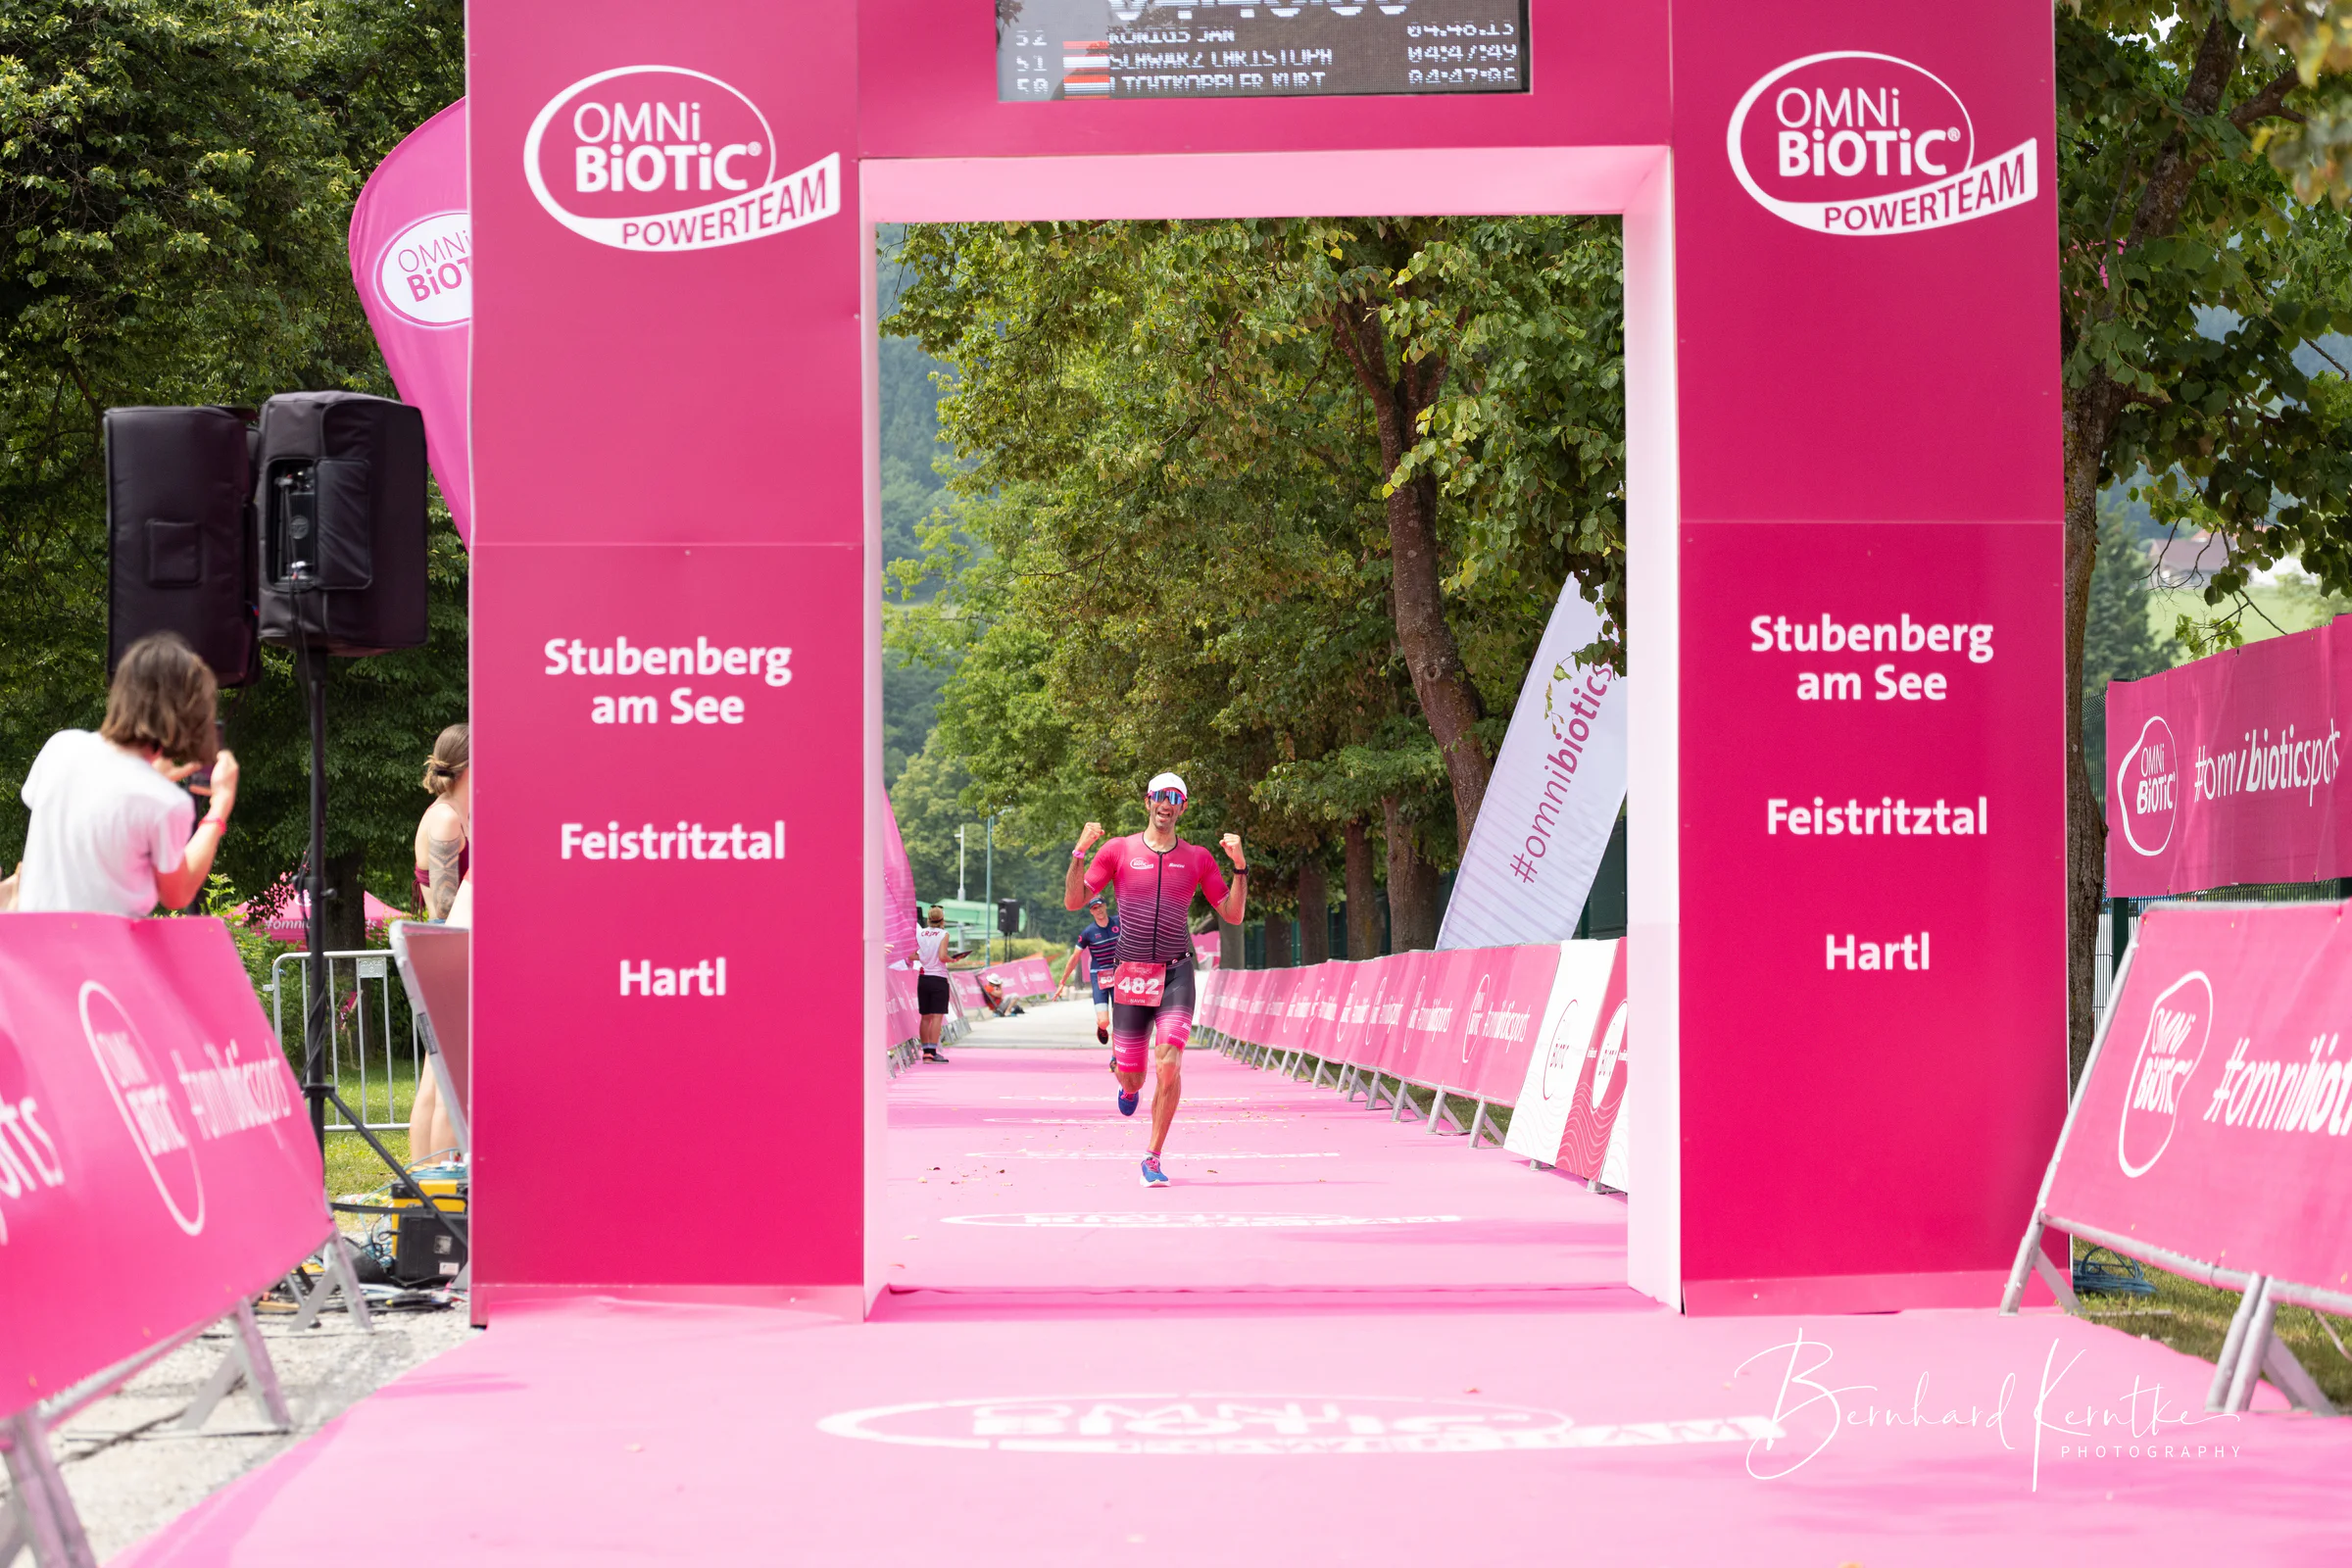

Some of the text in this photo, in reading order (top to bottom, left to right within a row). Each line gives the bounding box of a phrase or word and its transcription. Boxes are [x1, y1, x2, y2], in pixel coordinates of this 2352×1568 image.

[574, 102, 701, 143] OMNi
[1776, 87, 1900, 128] OMNi
[622, 167, 827, 247] POWERTEAM
[1824, 151, 2025, 231] POWERTEAM
[1750, 612, 1994, 663] Stubenberg
[544, 636, 793, 687] Stubenberg
[1797, 663, 1948, 701] am See
[591, 687, 745, 724] am See
[1767, 796, 1987, 835] Feistritztal
[561, 820, 786, 859] Feistritztal
[1826, 931, 1931, 970] Hartl
[619, 956, 726, 996] Hartl
[1117, 976, 1159, 996] 482
